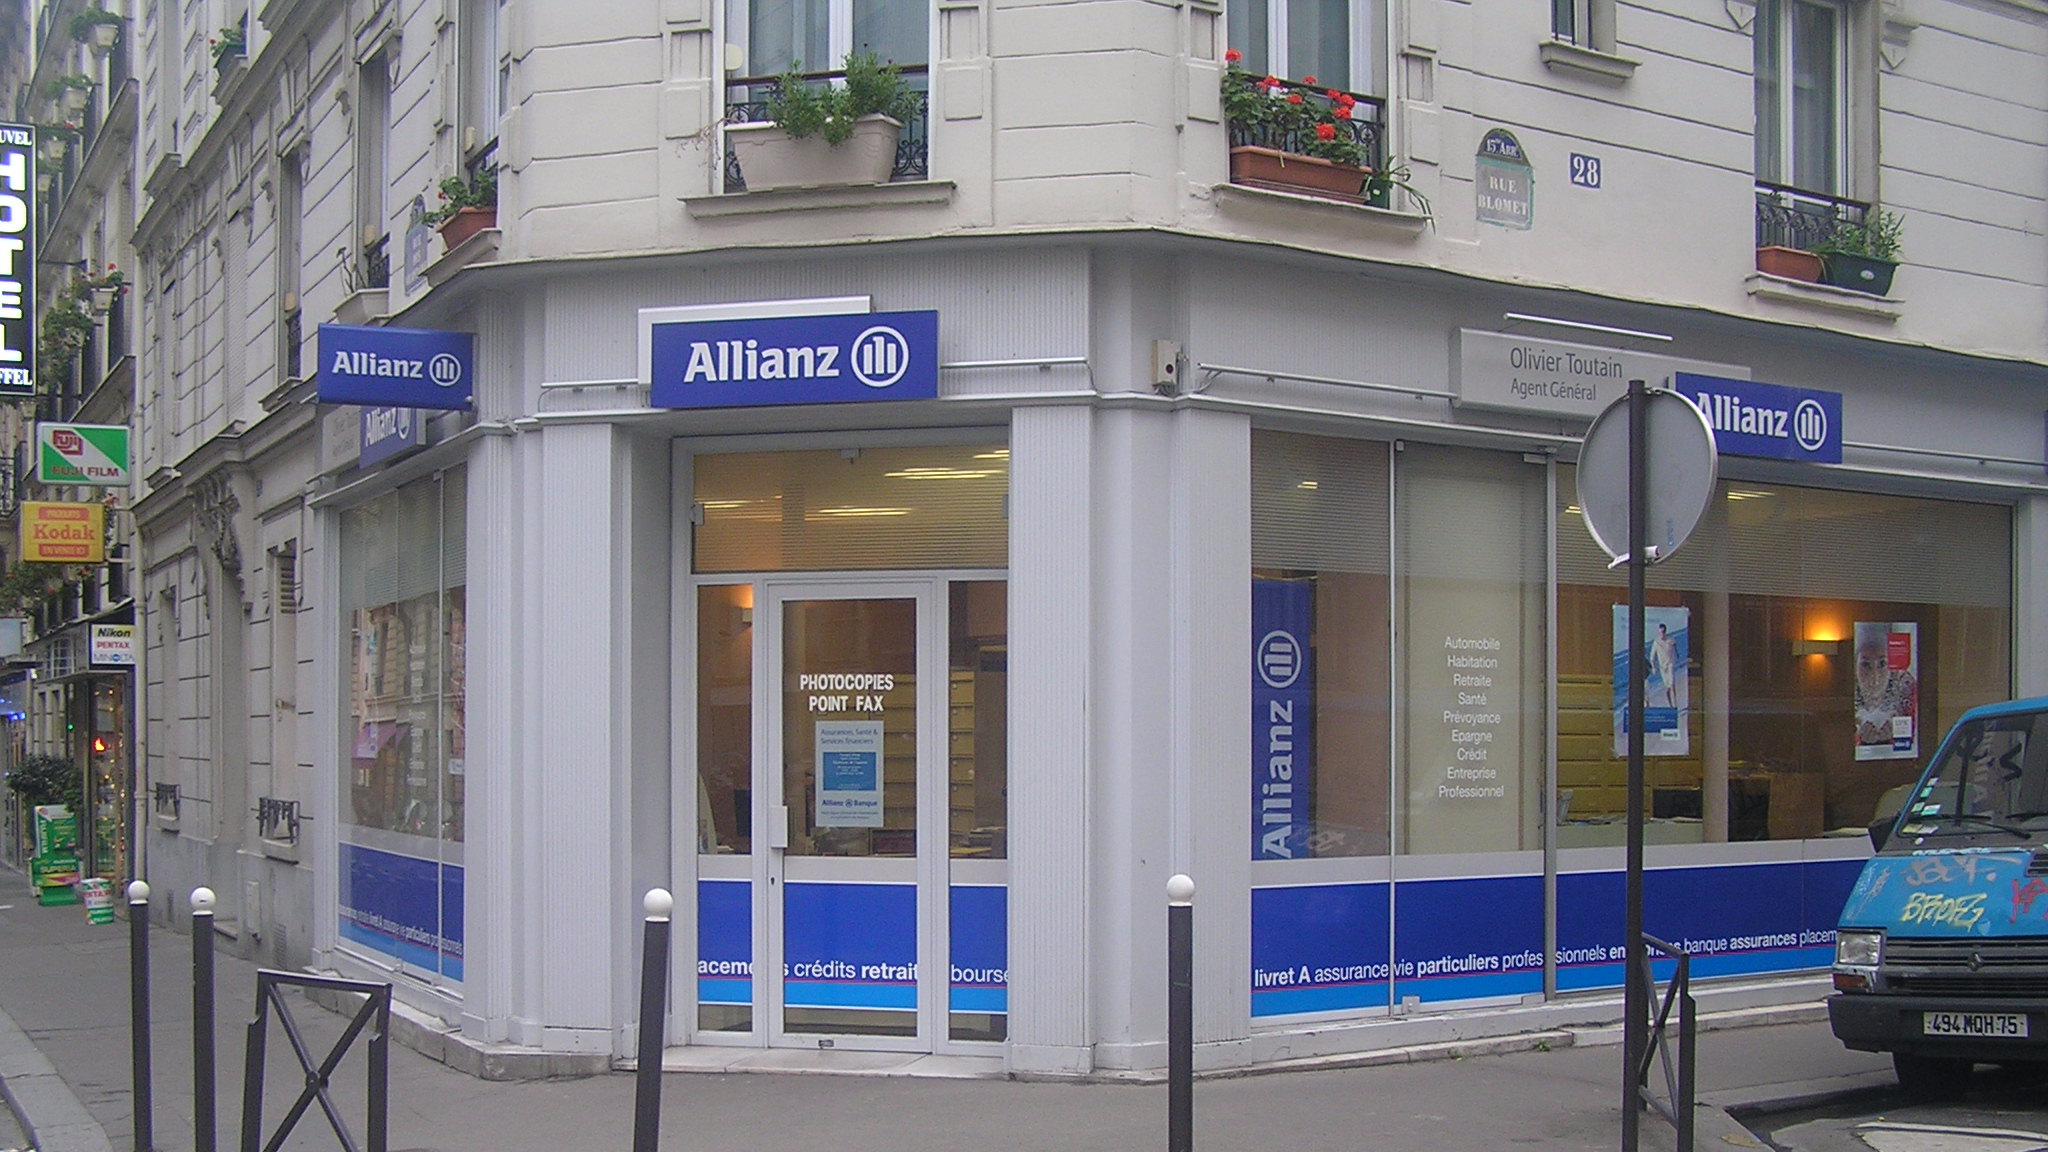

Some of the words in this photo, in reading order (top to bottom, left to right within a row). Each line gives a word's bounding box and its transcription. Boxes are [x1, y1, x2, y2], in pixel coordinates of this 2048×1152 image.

[1573, 156, 1599, 186] 28
[1489, 176, 1517, 193] RUE
[1477, 194, 1529, 216] BLOMET
[0, 153, 27, 361] HOTEL
[332, 351, 423, 379] Allianz
[683, 339, 840, 383] Allianz
[1510, 347, 1562, 373] Olivier
[1565, 352, 1623, 378] Toutain
[1510, 378, 1548, 400] Agent
[1550, 381, 1597, 401] Général
[1697, 391, 1788, 438] Allianz
[366, 406, 397, 448] Allianz
[87, 466, 120, 477] FILM
[33, 523, 96, 540] Kodak
[97, 627, 131, 638] Nikon
[96, 641, 131, 649] PENTAX
[1444, 636, 1501, 650] Automobile
[1447, 655, 1498, 669] Habitation
[800, 673, 895, 691] PHOTOCOPIES
[1453, 673, 1492, 687] Retraite
[809, 695, 848, 712] POINT
[856, 695, 884, 712] FAX
[1458, 692, 1487, 705] Santé
[1443, 711, 1501, 726] Prévoyance
[1451, 729, 1493, 745] Epargne
[1456, 747, 1487, 761] Crédit
[1262, 699, 1293, 859] Allianz
[1447, 766, 1497, 781] Entreprise
[1438, 785, 1505, 798] Professionnel
[794, 959, 856, 979] crédits
[1255, 968, 1295, 988] livret
[1298, 965, 1311, 984] A
[1315, 964, 1389, 983] assurance
[1394, 958, 1414, 976] vie
[1417, 953, 1499, 978] particuliers
[1684, 937, 1728, 955] banque
[1730, 933, 1797, 950] assurances
[1932, 1014, 1960, 1032] 494
[1997, 1016, 2018, 1035] 75
